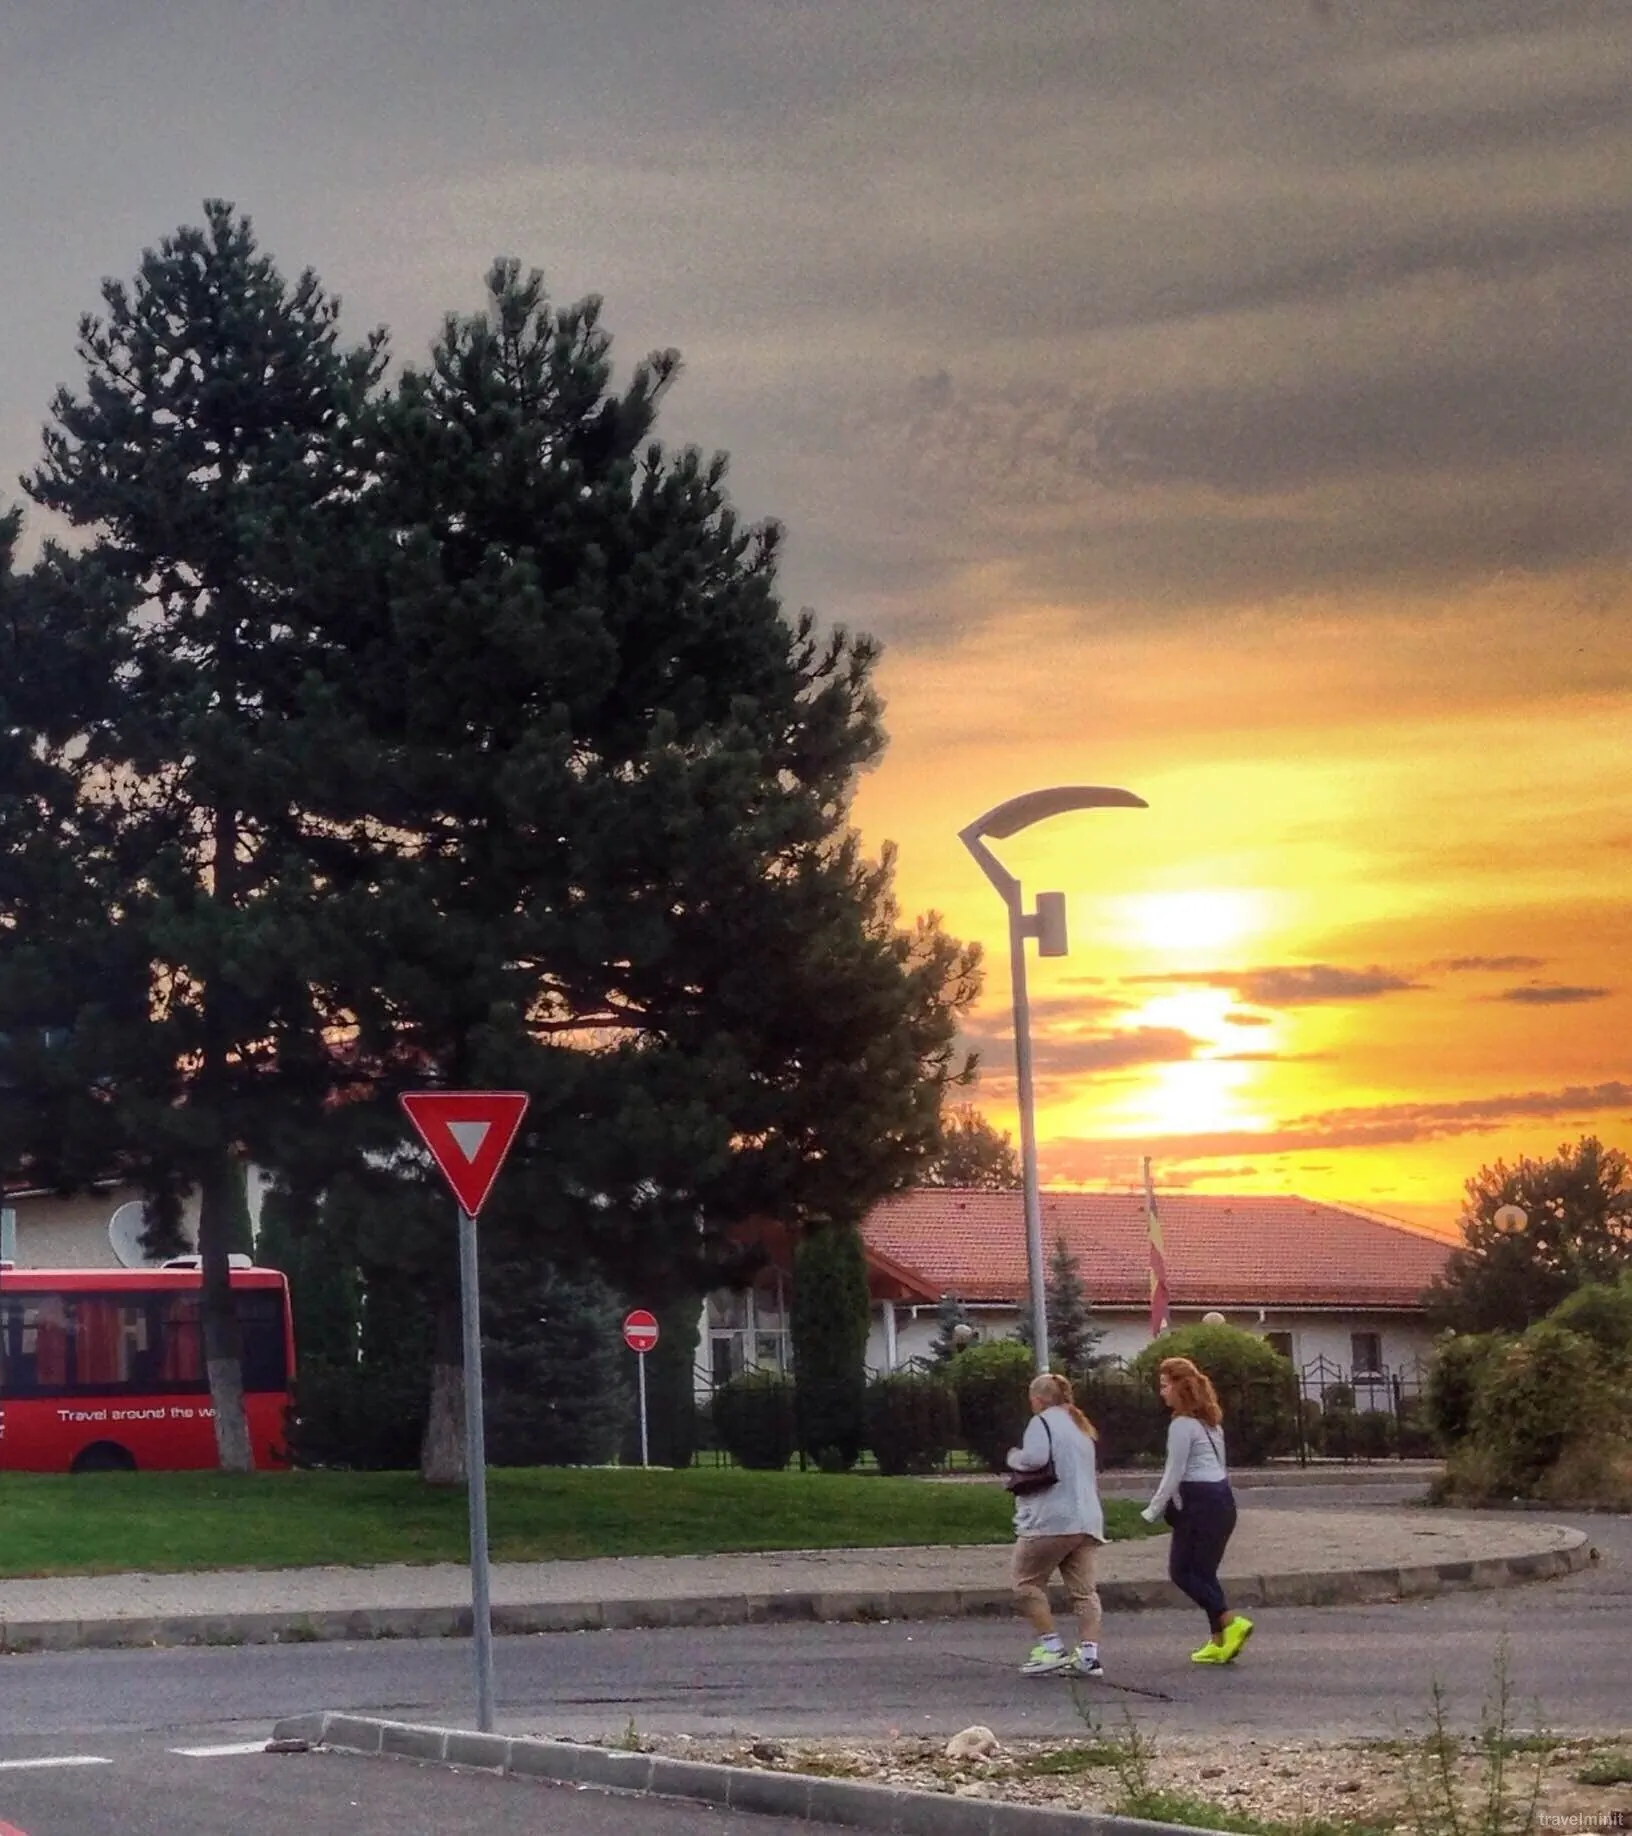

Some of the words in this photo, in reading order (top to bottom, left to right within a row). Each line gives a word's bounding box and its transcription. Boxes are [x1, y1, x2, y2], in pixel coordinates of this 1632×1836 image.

[56, 1409, 108, 1422] Travel
[112, 1407, 166, 1420] around
[170, 1406, 195, 1419] the
